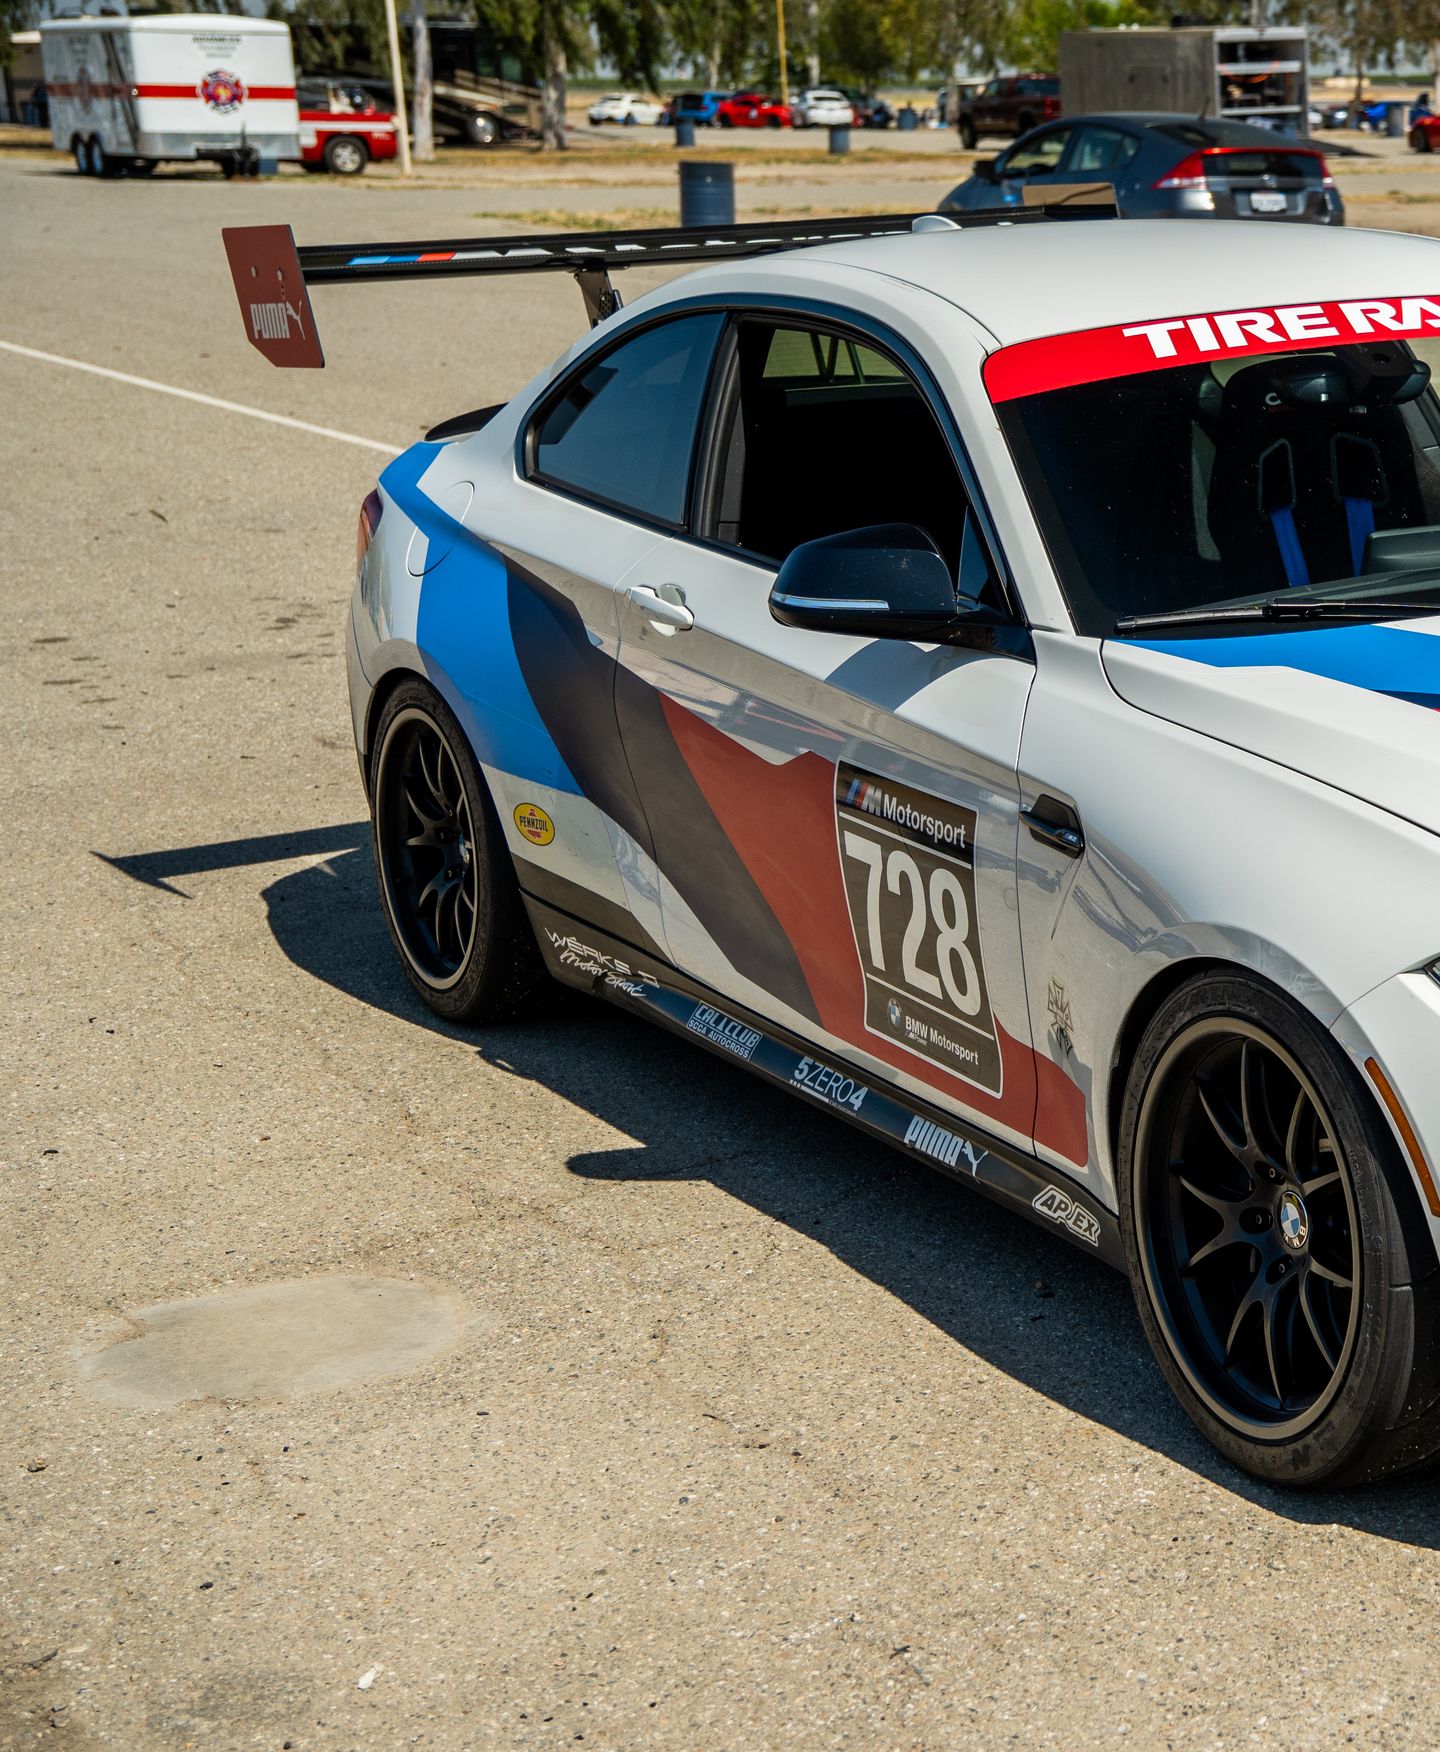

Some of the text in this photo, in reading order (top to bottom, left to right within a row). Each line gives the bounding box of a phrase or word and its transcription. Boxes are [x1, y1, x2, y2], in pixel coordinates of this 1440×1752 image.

[250, 303, 290, 339] PUMA
[1122, 304, 1340, 359] TIRE
[519, 815, 549, 832] PENNZOIL
[883, 793, 966, 848] Motorsport
[844, 830, 981, 1016] 728
[688, 1019, 750, 1058] SCCA AUTOCROSS
[905, 1015, 979, 1066] BMW Motorsport
[903, 1114, 964, 1167] PUMA
